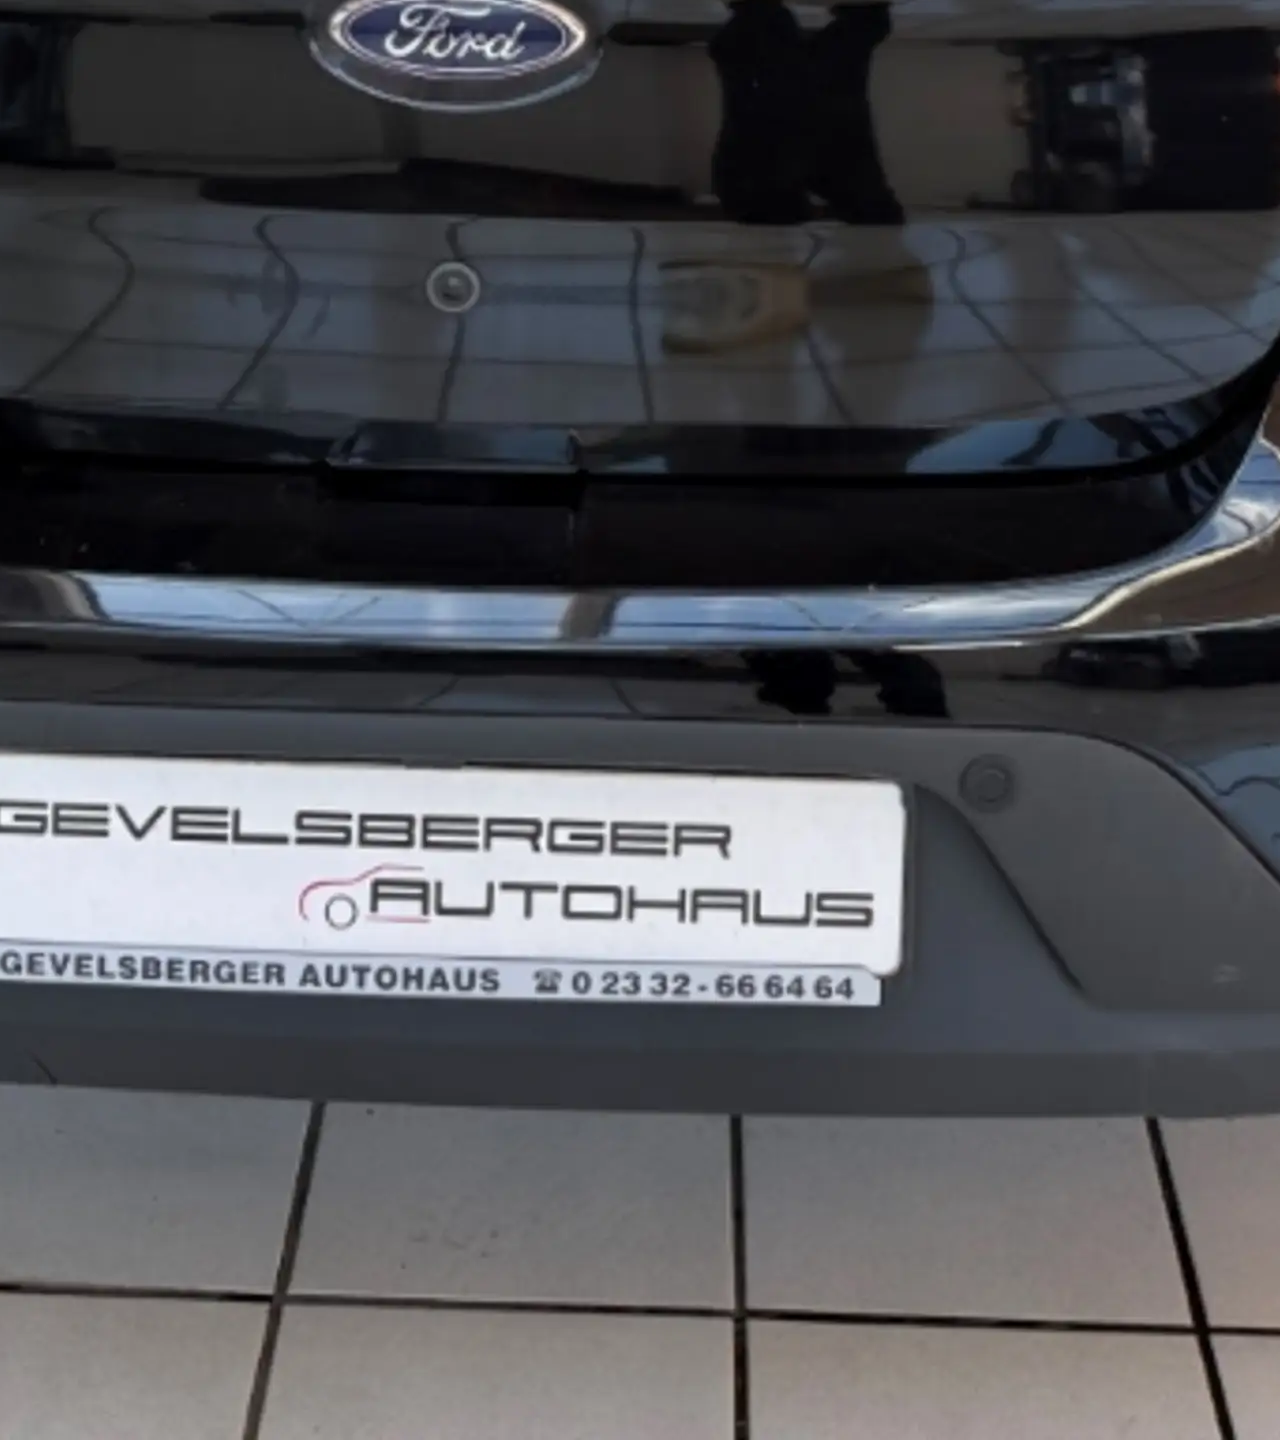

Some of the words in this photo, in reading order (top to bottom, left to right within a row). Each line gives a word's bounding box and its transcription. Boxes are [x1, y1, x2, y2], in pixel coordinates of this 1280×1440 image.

[384, 3, 526, 60] Ford
[370, 877, 874, 928] AUTOHAUS
[298, 962, 501, 994] AUTOHAUS
